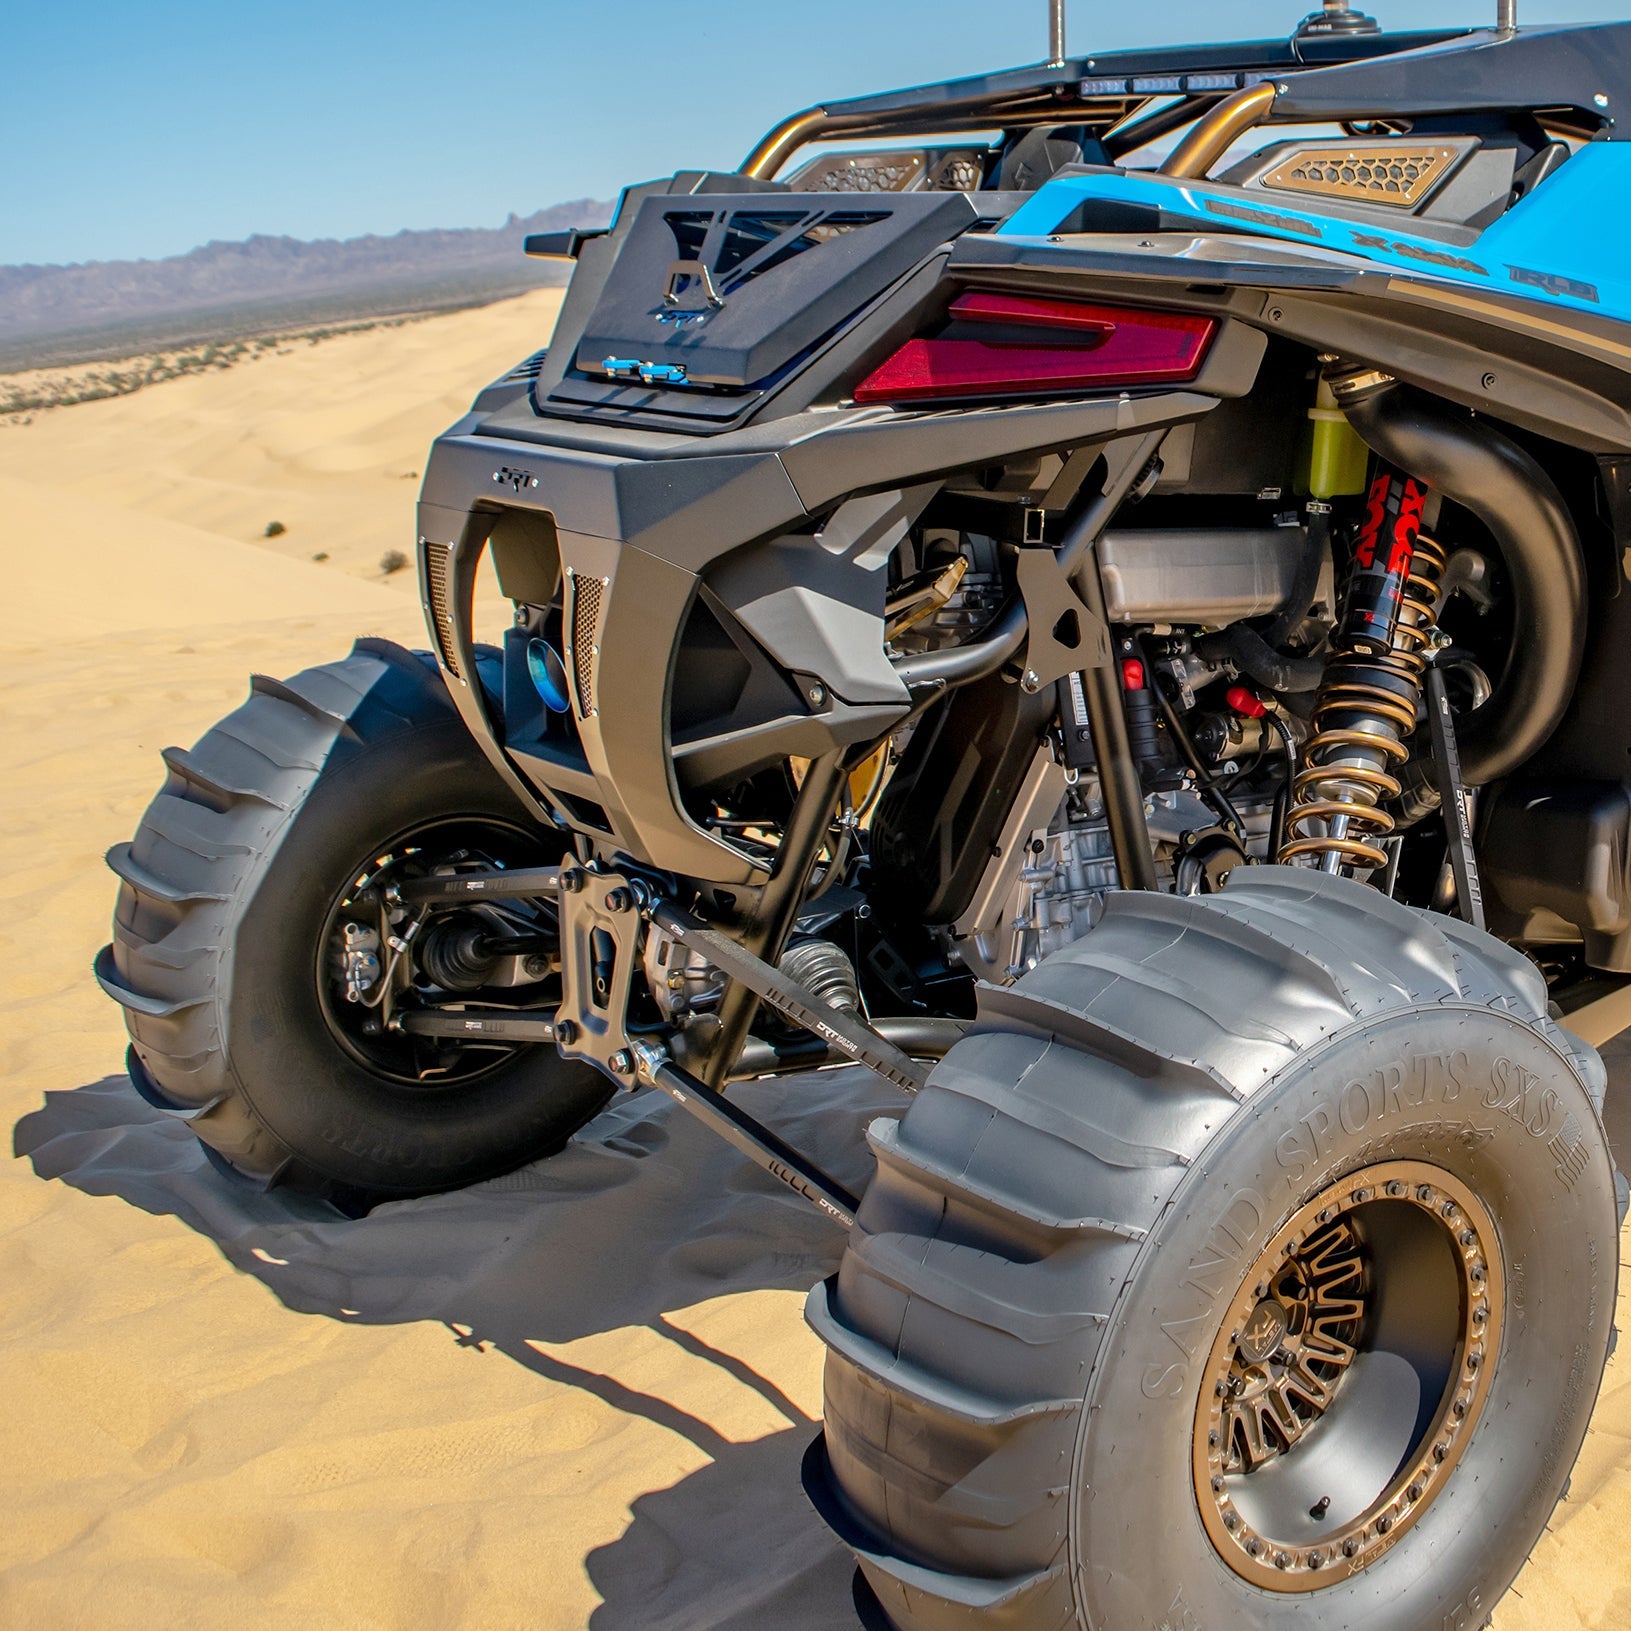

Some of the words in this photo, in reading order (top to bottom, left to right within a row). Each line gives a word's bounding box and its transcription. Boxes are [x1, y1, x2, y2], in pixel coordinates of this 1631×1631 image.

[816, 1021, 839, 1038] DRT
[819, 1198, 841, 1215] DRT
[1141, 1187, 1265, 1400] SAND
[1274, 1049, 1469, 1189] SPORTS
[1481, 1056, 1560, 1137] SXS
